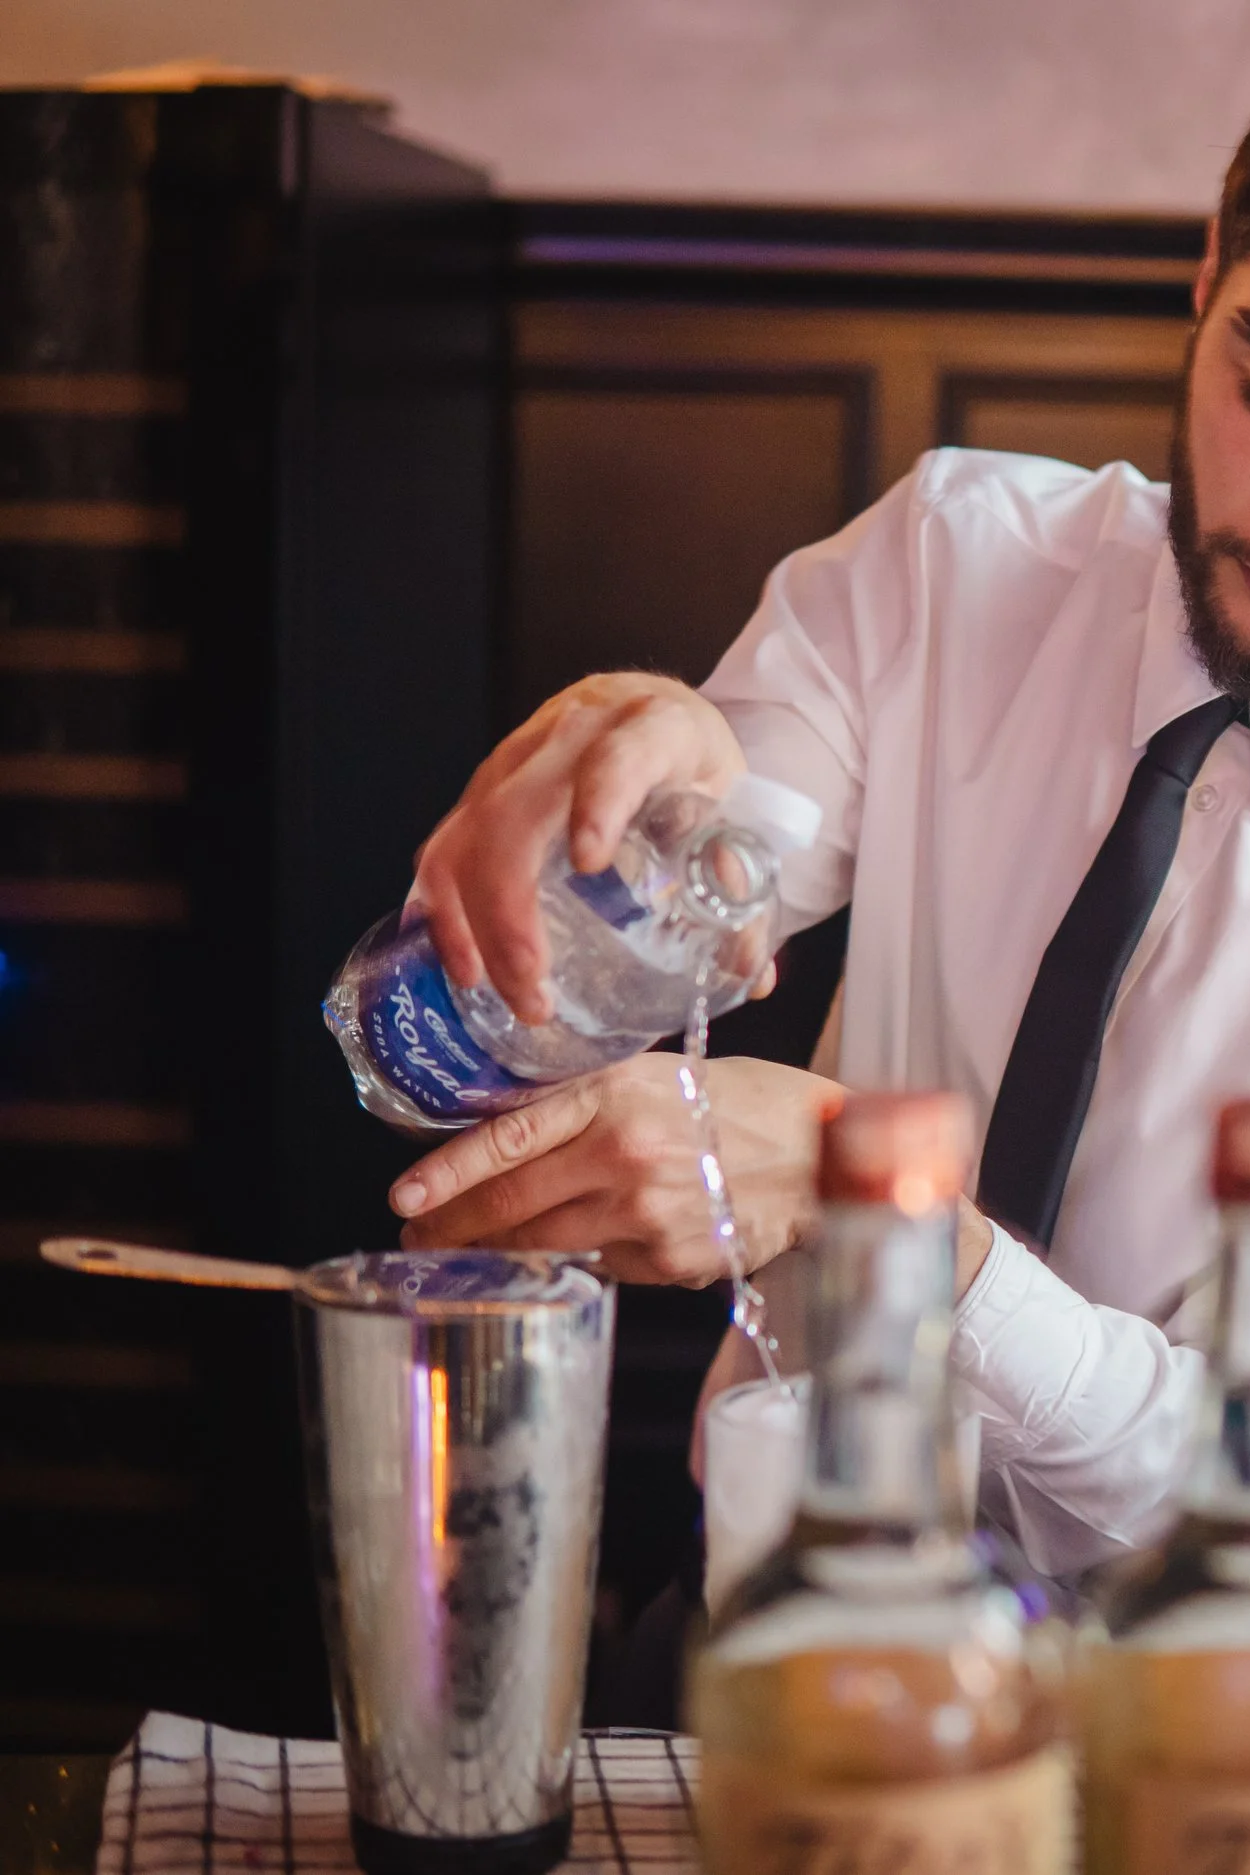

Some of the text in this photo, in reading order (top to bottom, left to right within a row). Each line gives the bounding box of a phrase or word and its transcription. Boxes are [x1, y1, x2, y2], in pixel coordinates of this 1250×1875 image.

[372, 1012, 442, 1109] SODA WATER
[390, 983, 490, 1101] Royal
